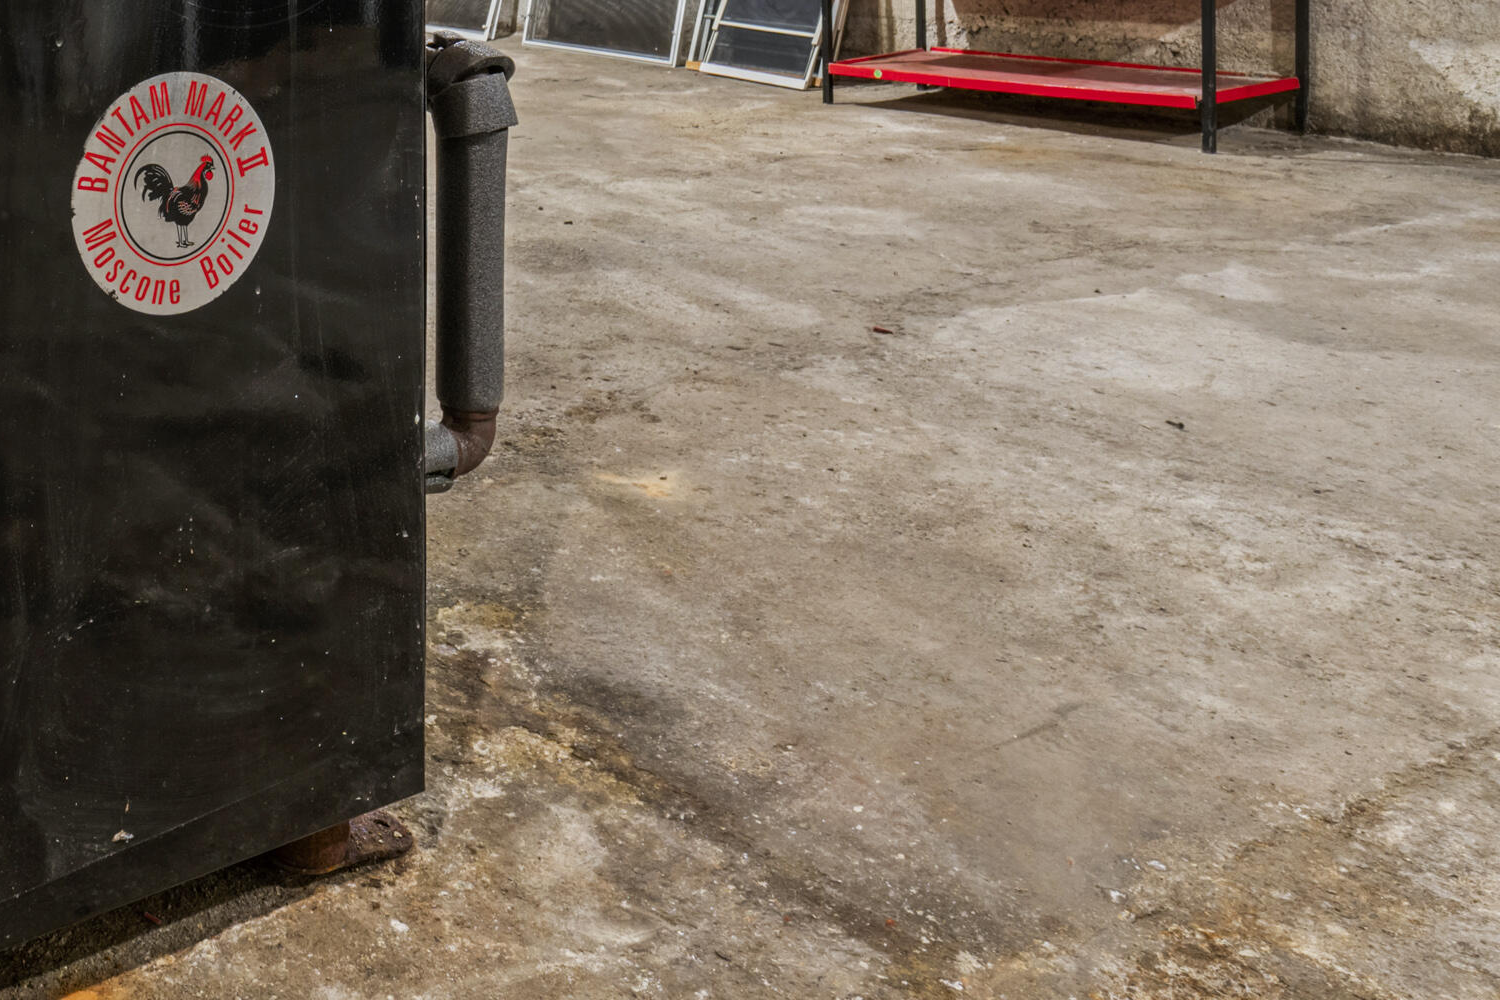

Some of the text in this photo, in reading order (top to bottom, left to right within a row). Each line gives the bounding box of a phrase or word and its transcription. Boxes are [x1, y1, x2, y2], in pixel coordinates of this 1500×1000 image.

[77, 80, 269, 193] BANTAM MARK II
[82, 204, 263, 305] Moscone Boiler
